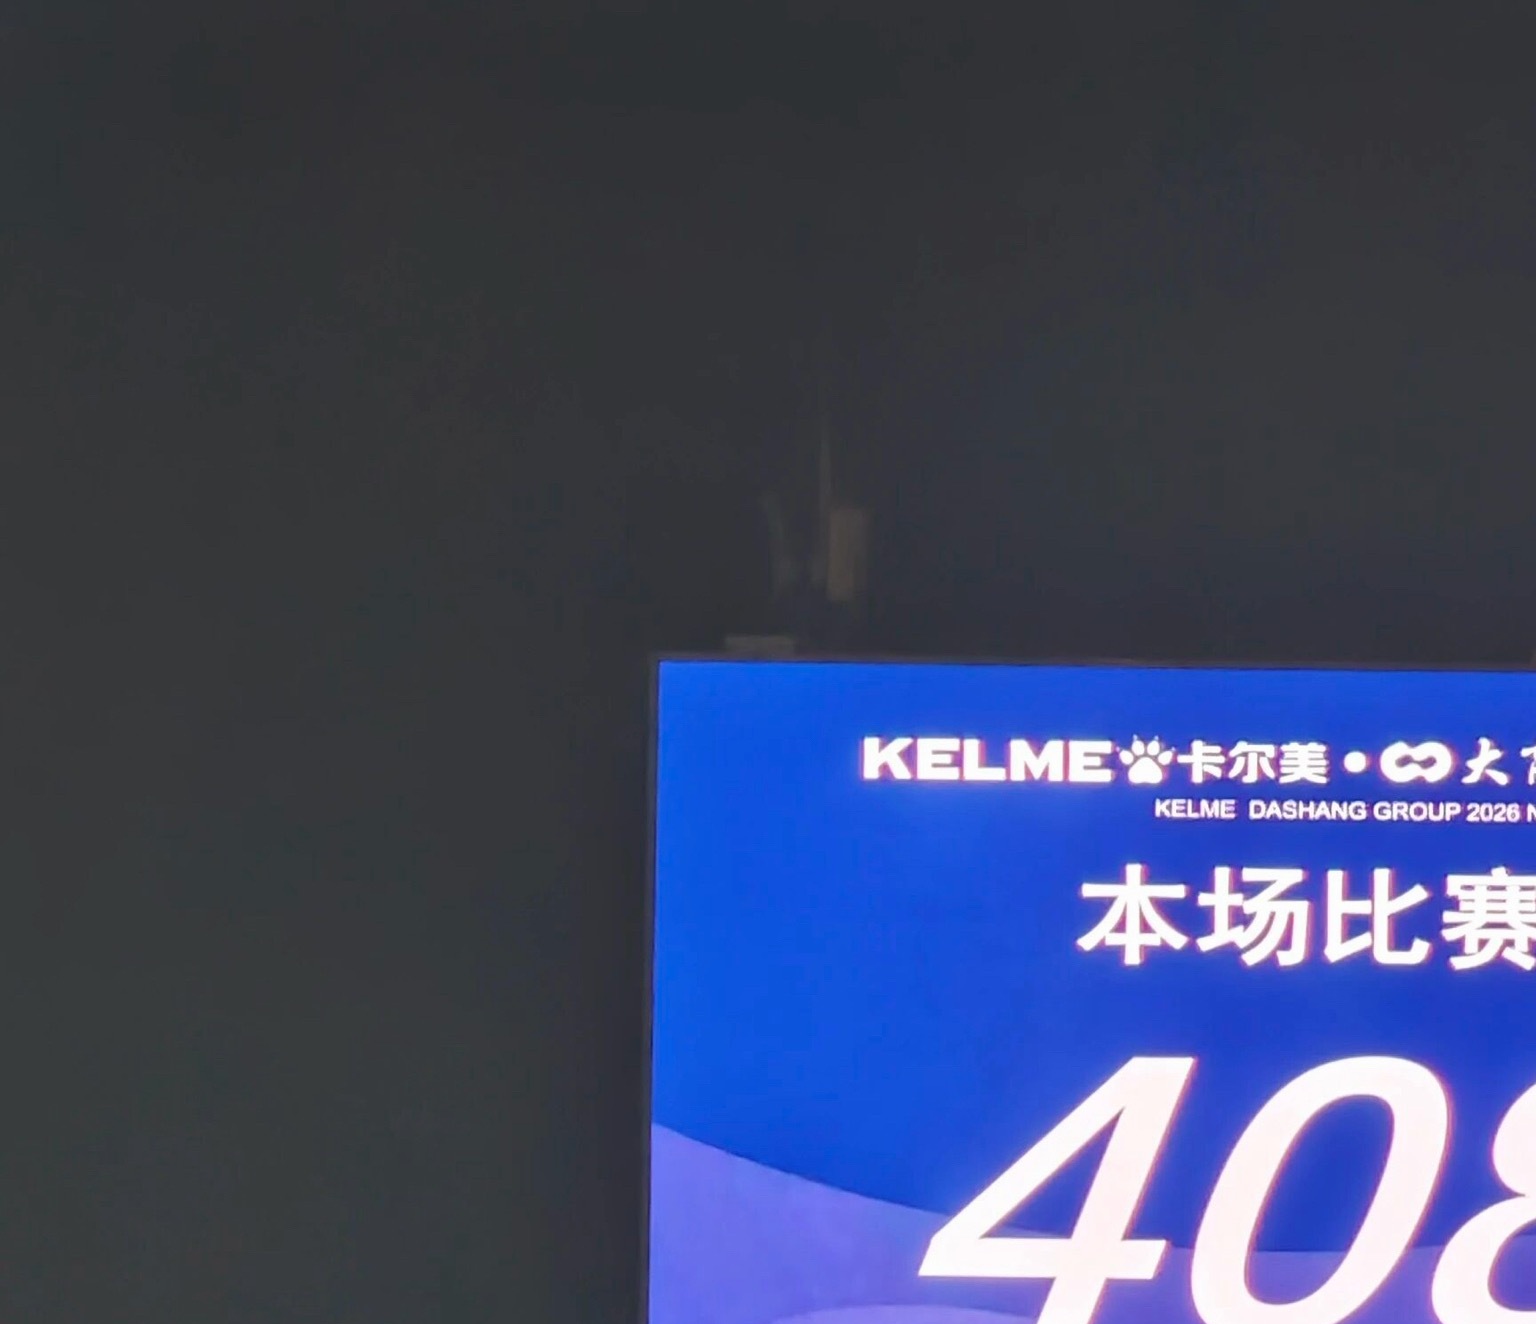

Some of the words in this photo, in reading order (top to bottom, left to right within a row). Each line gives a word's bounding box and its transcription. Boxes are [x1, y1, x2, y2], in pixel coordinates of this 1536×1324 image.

[862, 736, 1114, 782] KELME
[1177, 739, 1330, 785] 卡尔美
[1154, 798, 1236, 820] KELME
[1249, 800, 1368, 821] DASHANG
[1373, 801, 1461, 822] GROUP
[1466, 803, 1520, 823] 2026
